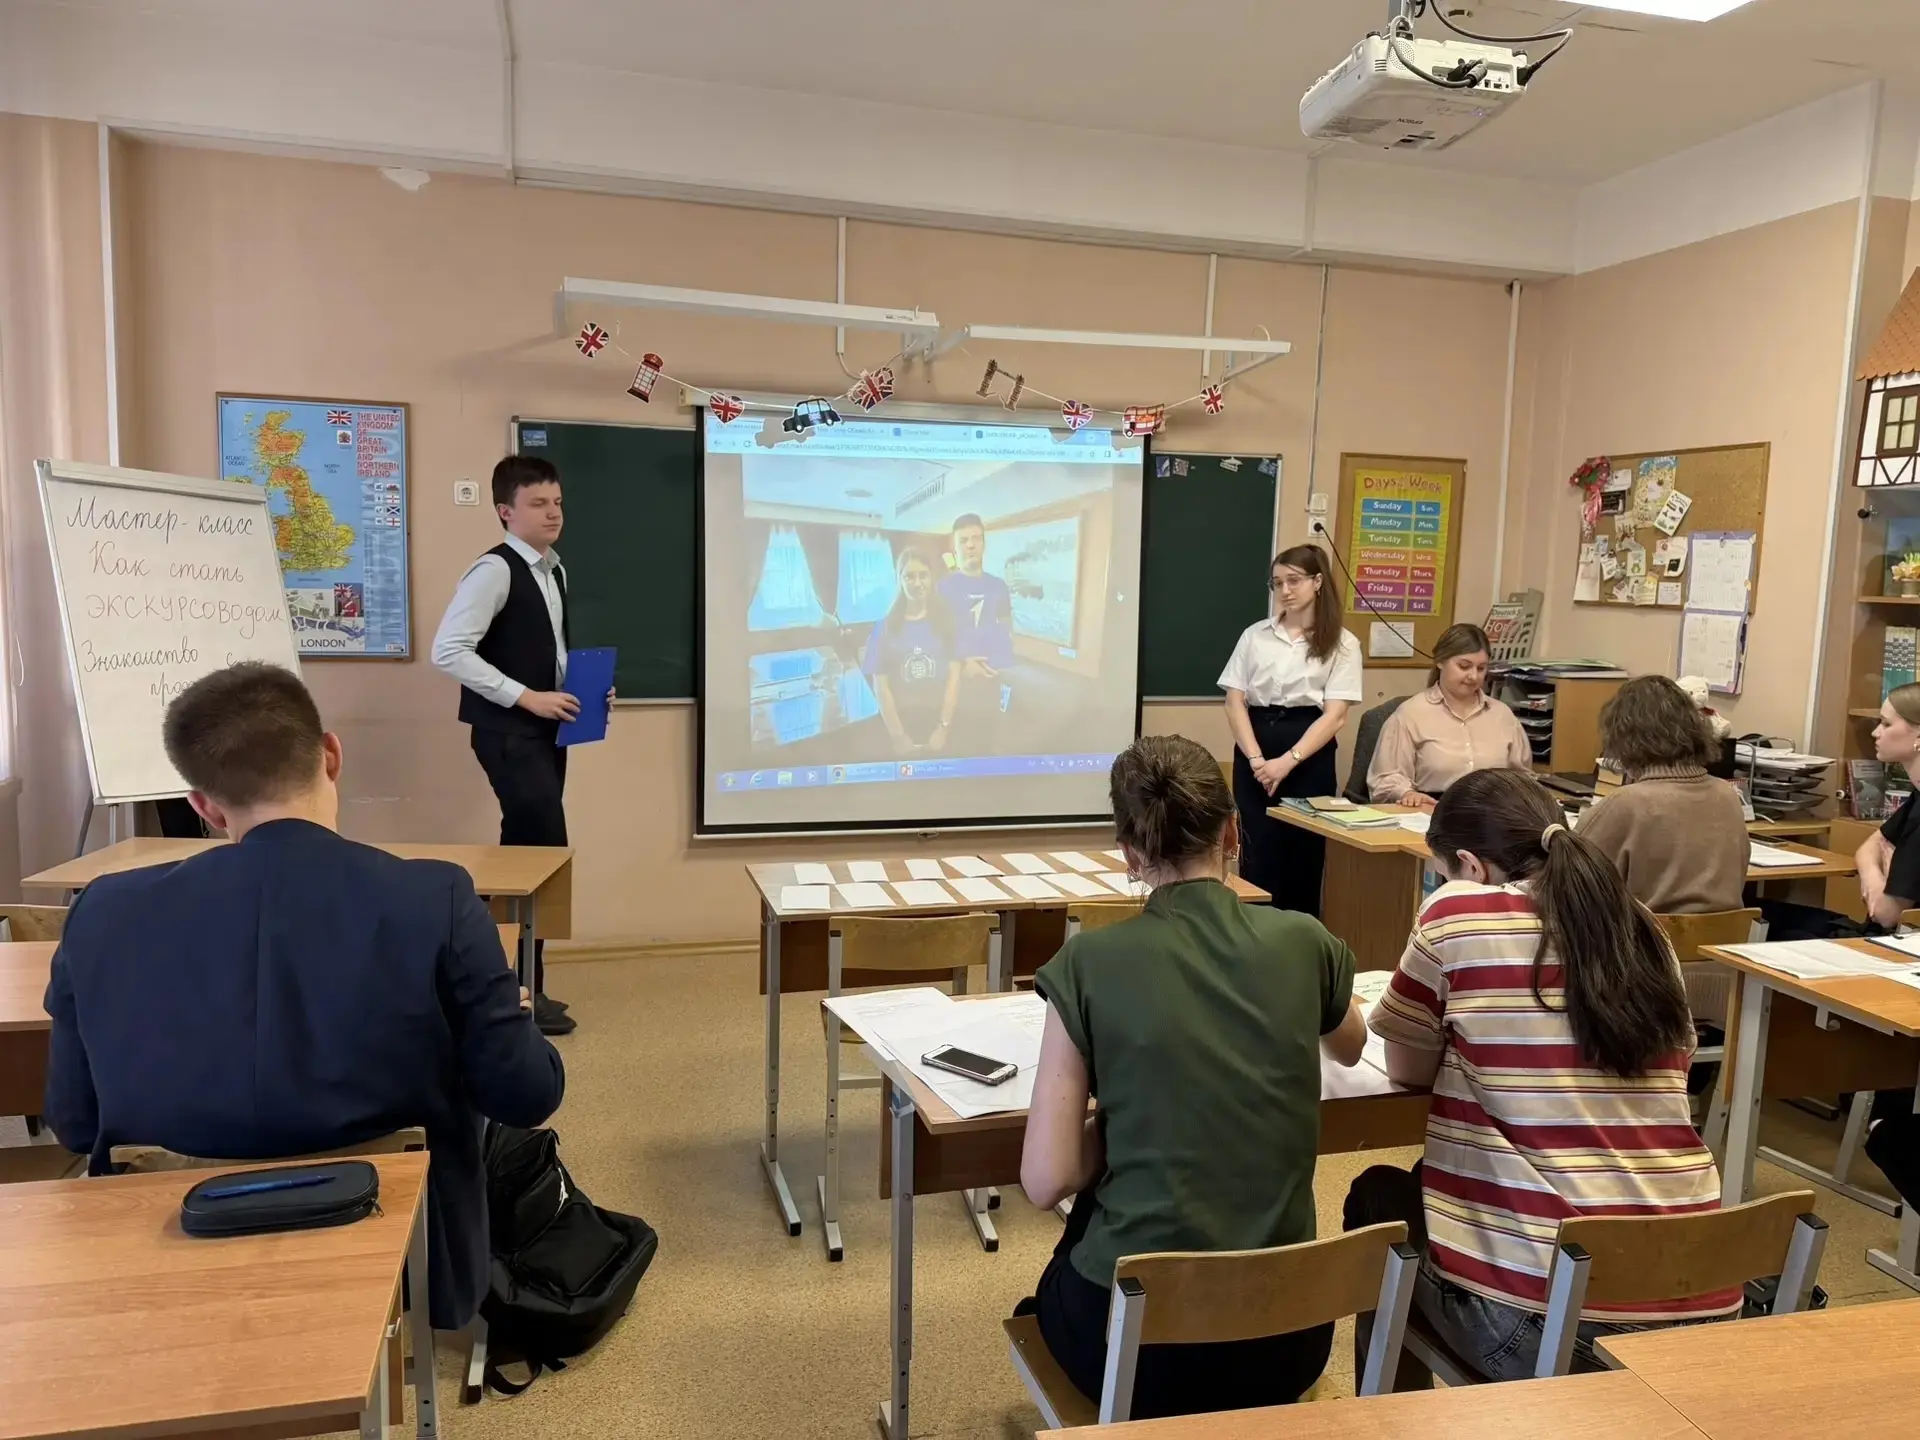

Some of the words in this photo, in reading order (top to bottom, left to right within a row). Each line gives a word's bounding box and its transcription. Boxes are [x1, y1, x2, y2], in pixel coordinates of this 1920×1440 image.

[357, 420, 394, 430] KINGDOM
[357, 436, 383, 446] GREAT
[357, 444, 388, 454] BRITAIN
[357, 453, 374, 461] AND
[357, 461, 400, 471] NORTHERN
[1363, 476, 1397, 489] Days
[1409, 475, 1442, 494] Week
[1373, 501, 1402, 512] Sunday
[1370, 517, 1402, 528] Monday
[1368, 534, 1401, 545] Tuesday
[1360, 550, 1406, 561] Wednesday
[89, 540, 150, 577] Как
[169, 561, 244, 583] стать
[1364, 567, 1400, 578] Thursday
[1367, 583, 1394, 594] Friday
[300, 638, 346, 648] LONDON
[81, 635, 199, 673] Знакомство
